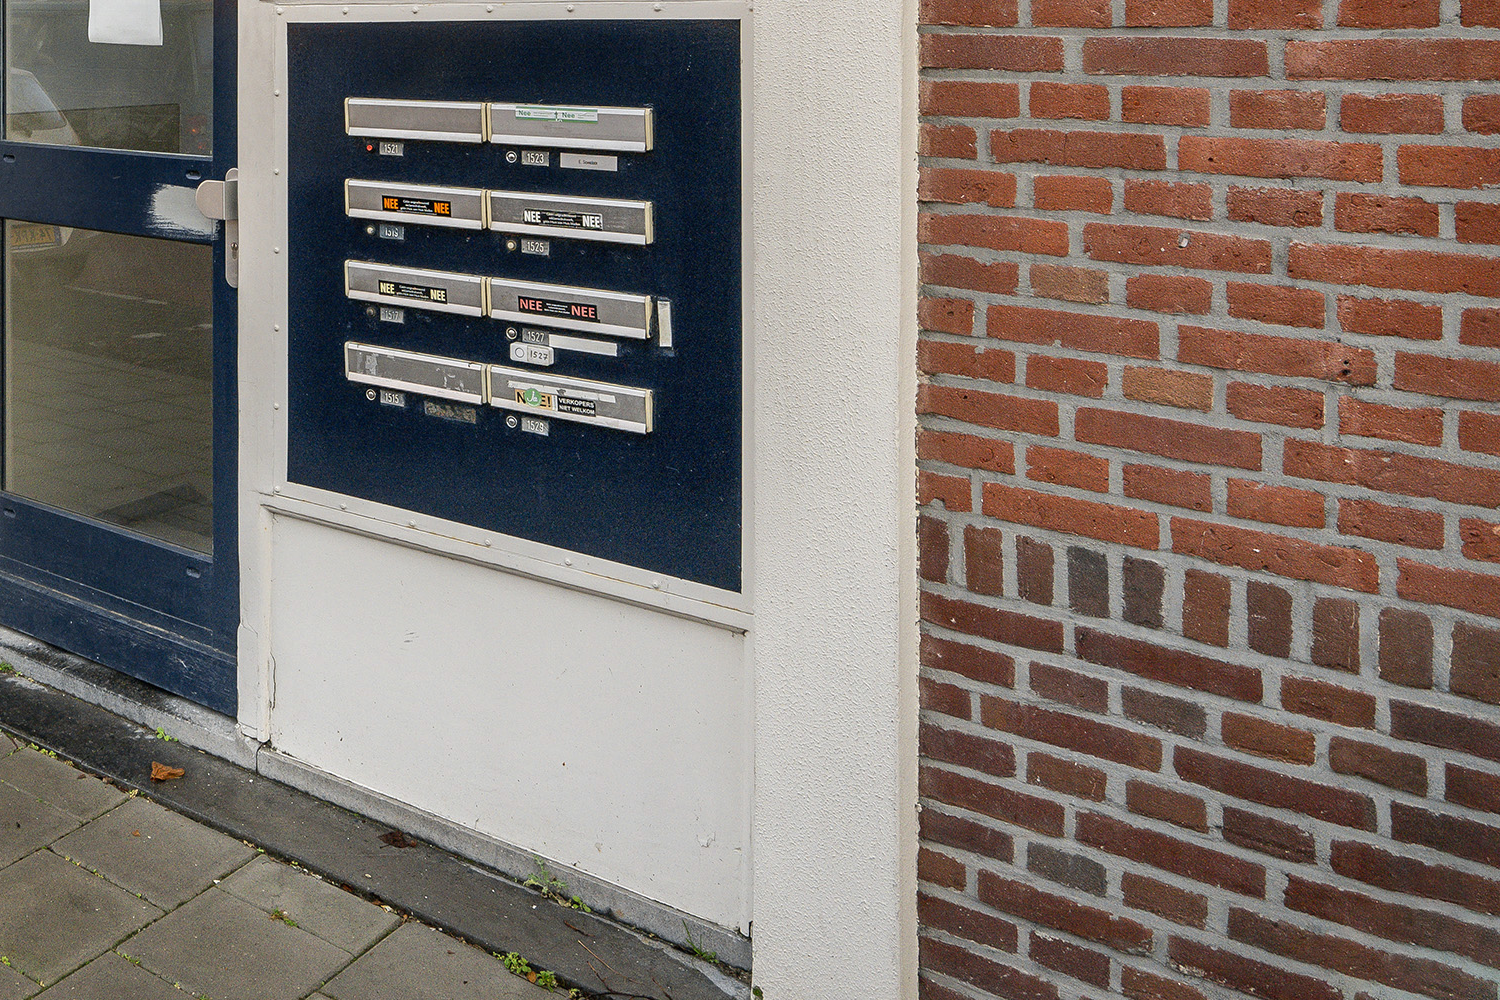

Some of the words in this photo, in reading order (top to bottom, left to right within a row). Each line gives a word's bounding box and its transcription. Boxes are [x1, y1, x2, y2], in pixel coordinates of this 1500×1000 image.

[384, 143, 398, 154] 1521
[526, 153, 544, 164] 1523
[383, 198, 399, 209] NEE
[434, 202, 450, 214] NEE
[524, 210, 541, 223] NEE
[527, 241, 544, 253] 1525
[380, 282, 395, 294] NEE
[430, 289, 446, 301] NEE
[520, 299, 543, 311] NEE
[571, 305, 595, 318] NEE
[527, 331, 545, 343] 1527
[530, 350, 548, 360] 1527
[385, 393, 399, 404] 1515
[517, 391, 551, 407] NE!
[559, 397, 595, 408] VERKOPERS
[572, 407, 595, 415] WELKOM
[527, 420, 544, 432] 1529
